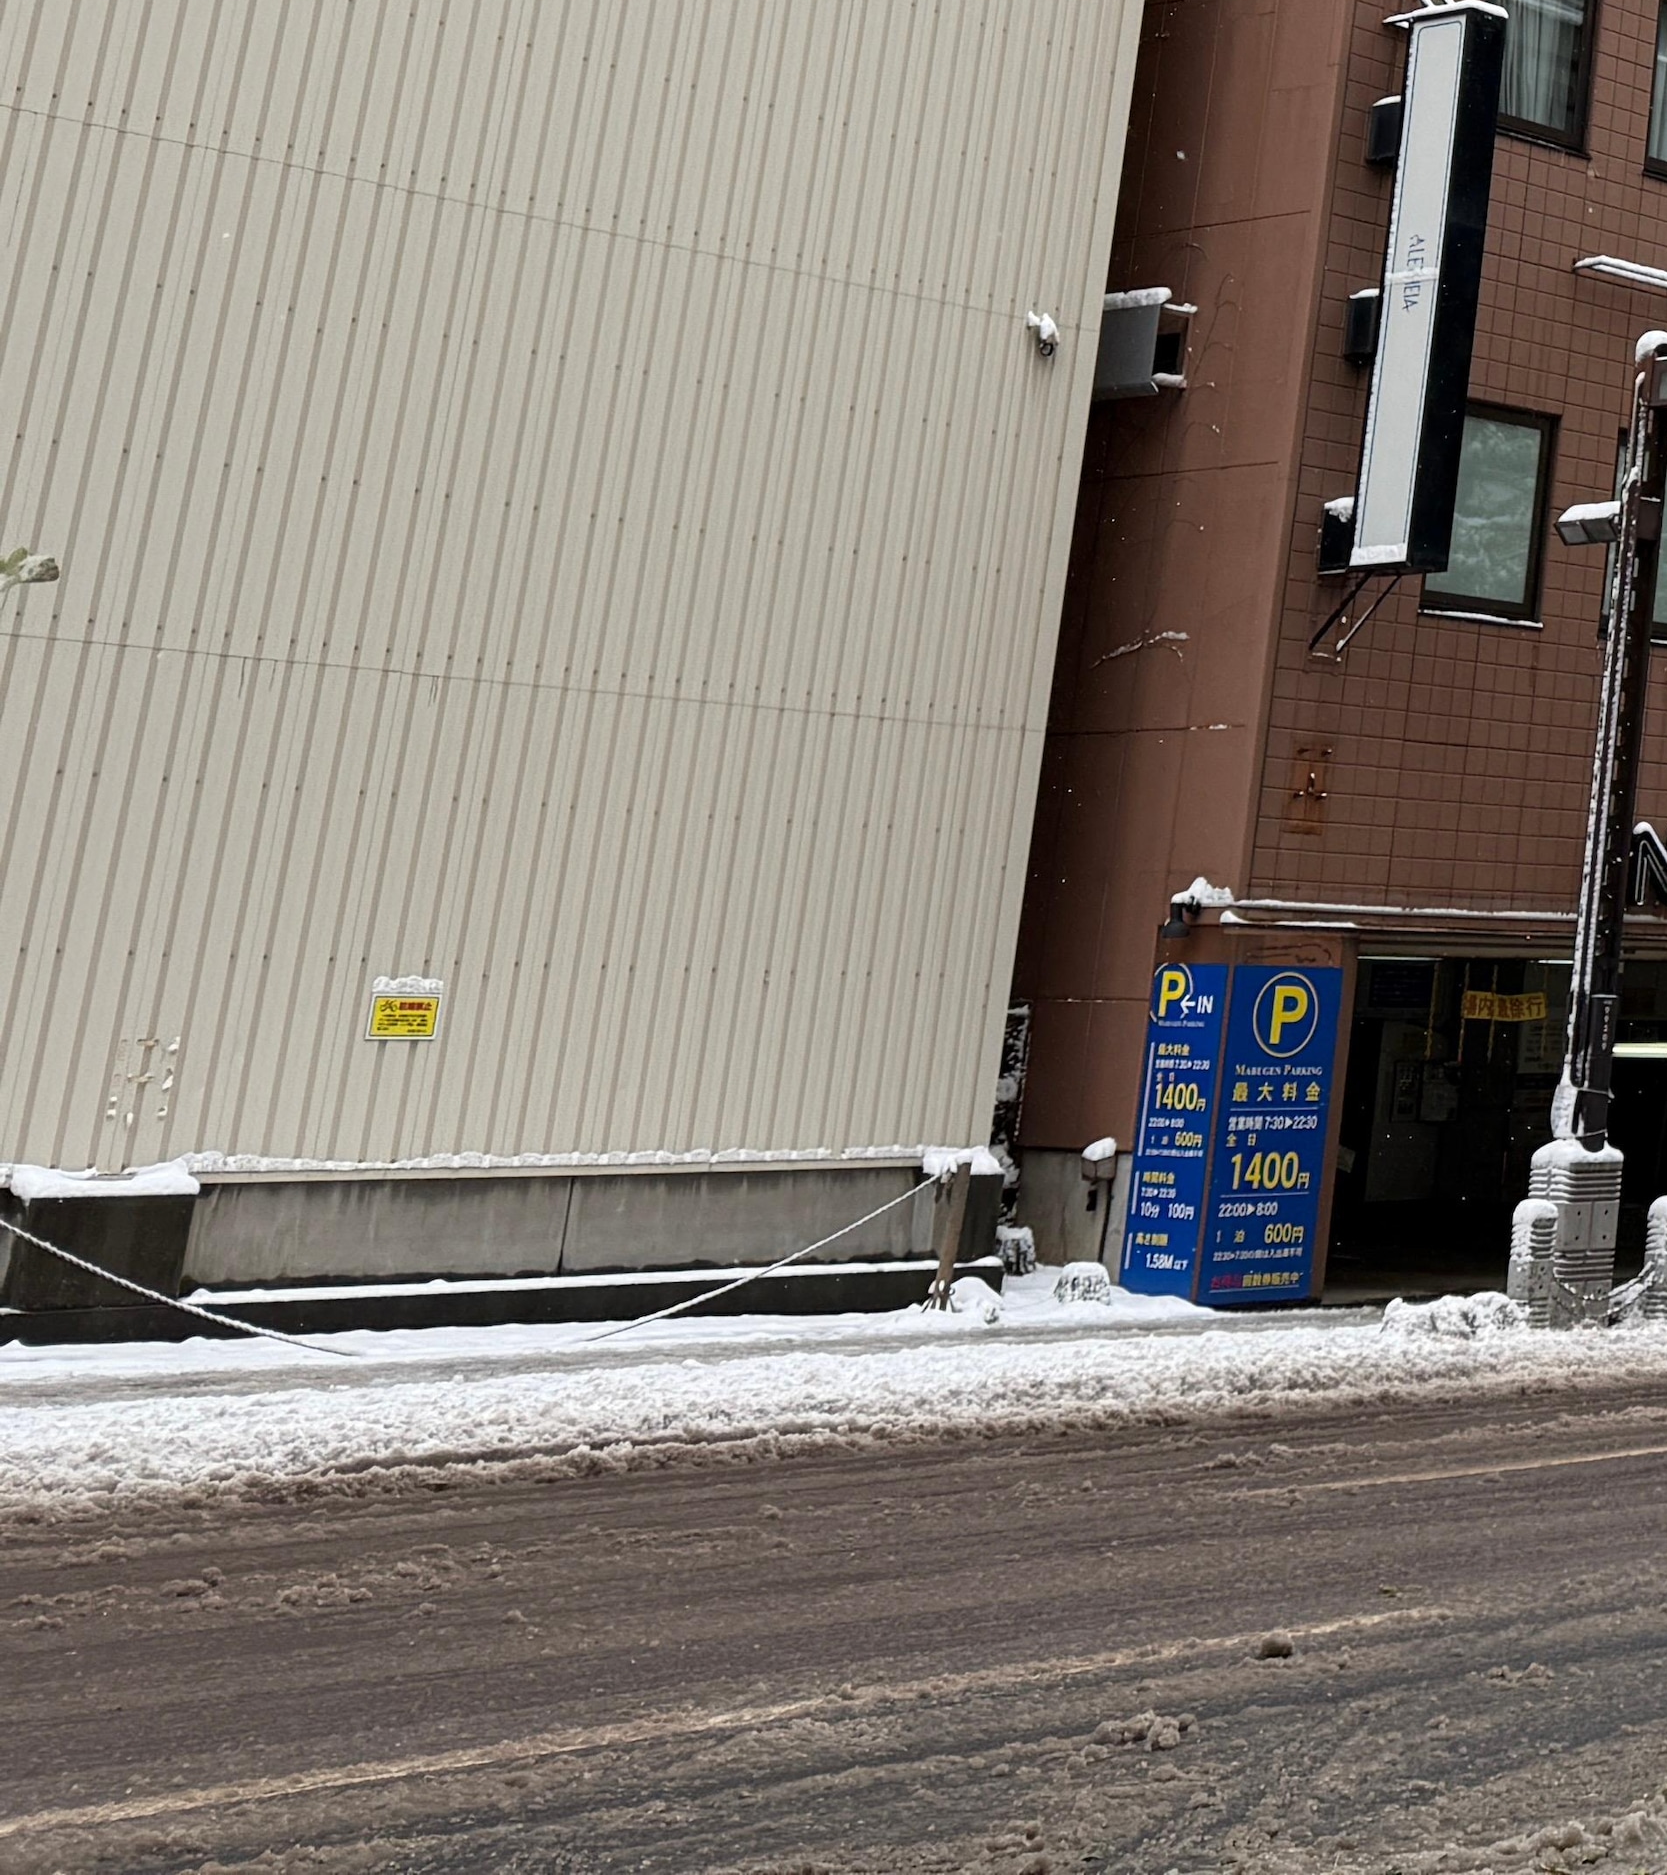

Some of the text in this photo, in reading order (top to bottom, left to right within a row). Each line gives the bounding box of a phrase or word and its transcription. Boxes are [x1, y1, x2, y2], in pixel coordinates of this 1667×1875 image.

[1196, 995, 1214, 1014] IN
[1269, 985, 1309, 1045] P
[1155, 1082, 1207, 1112] 1400円
[1232, 1081, 1321, 1102] 最大料金
[1231, 1151, 1310, 1190] 1400円
[1168, 1202, 1195, 1221] 100円
[1264, 1223, 1305, 1244] 600円
